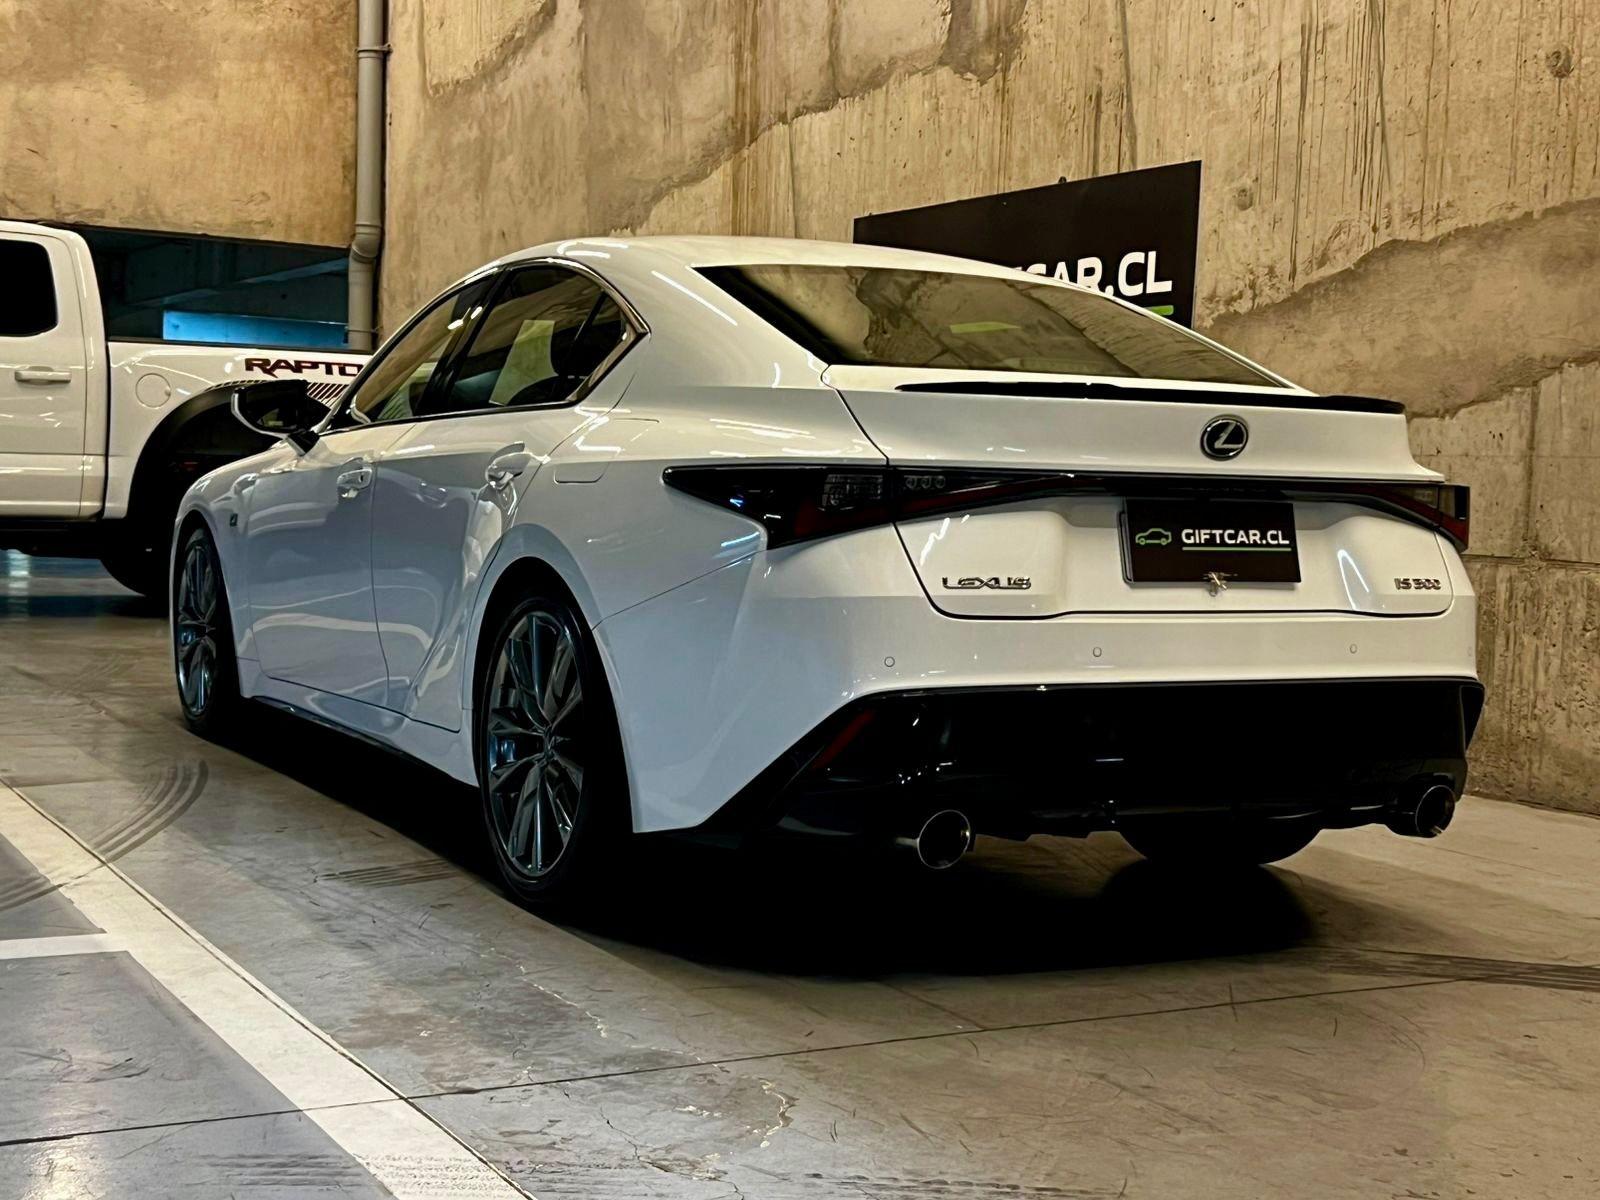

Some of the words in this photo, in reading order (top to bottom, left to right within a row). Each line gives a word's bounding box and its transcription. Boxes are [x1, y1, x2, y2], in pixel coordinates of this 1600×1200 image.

[245, 358, 363, 378] RAPTO
[1181, 528, 1290, 545] GIFTCAR.CL
[942, 577, 1032, 590] LEXUS
